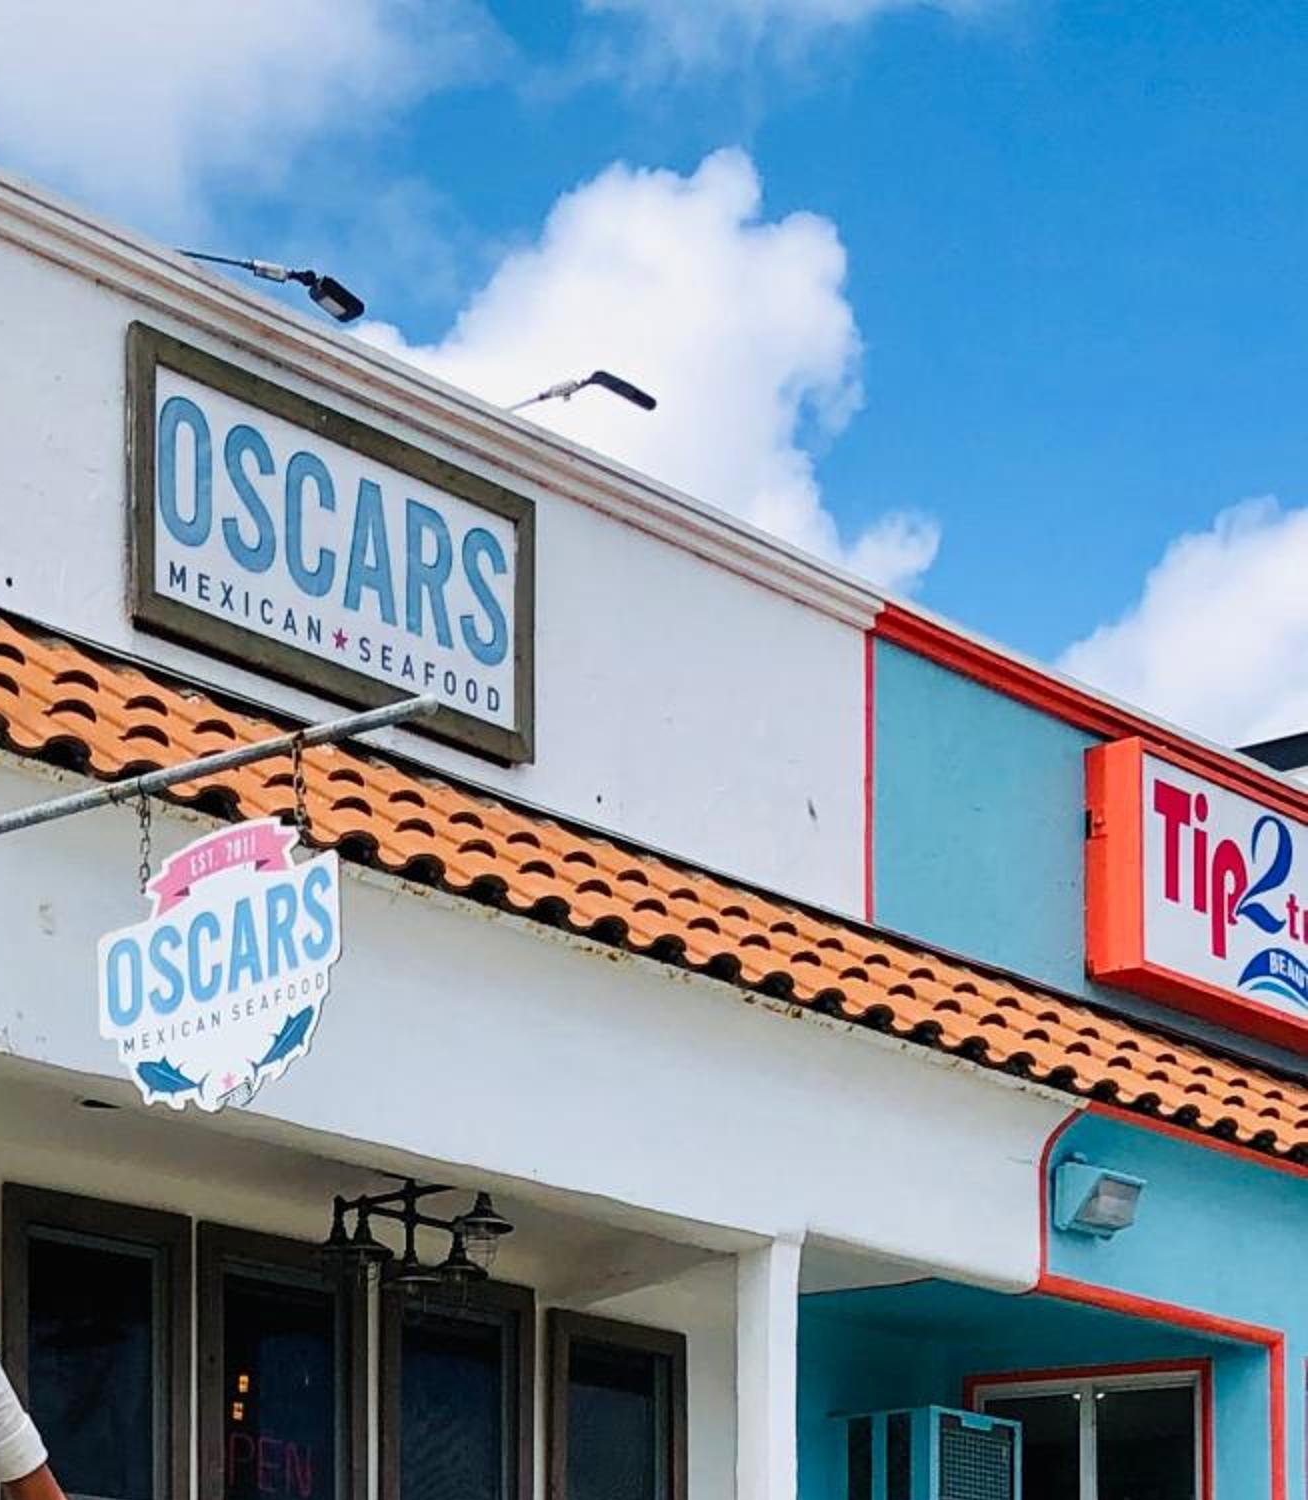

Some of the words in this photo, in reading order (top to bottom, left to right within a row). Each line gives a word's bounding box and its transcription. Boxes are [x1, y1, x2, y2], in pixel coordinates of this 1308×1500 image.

[158, 395, 508, 667] OSCARS
[168, 561, 323, 645] MEXICAN
[359, 638, 501, 713] SEAFOOD
[106, 865, 333, 1027] OSCARS
[1153, 778, 1248, 960] Tip
[123, 1010, 222, 1055] MEXICAN
[231, 972, 325, 1022] SEAFOOD
[228, 1432, 313, 1498] PEN
